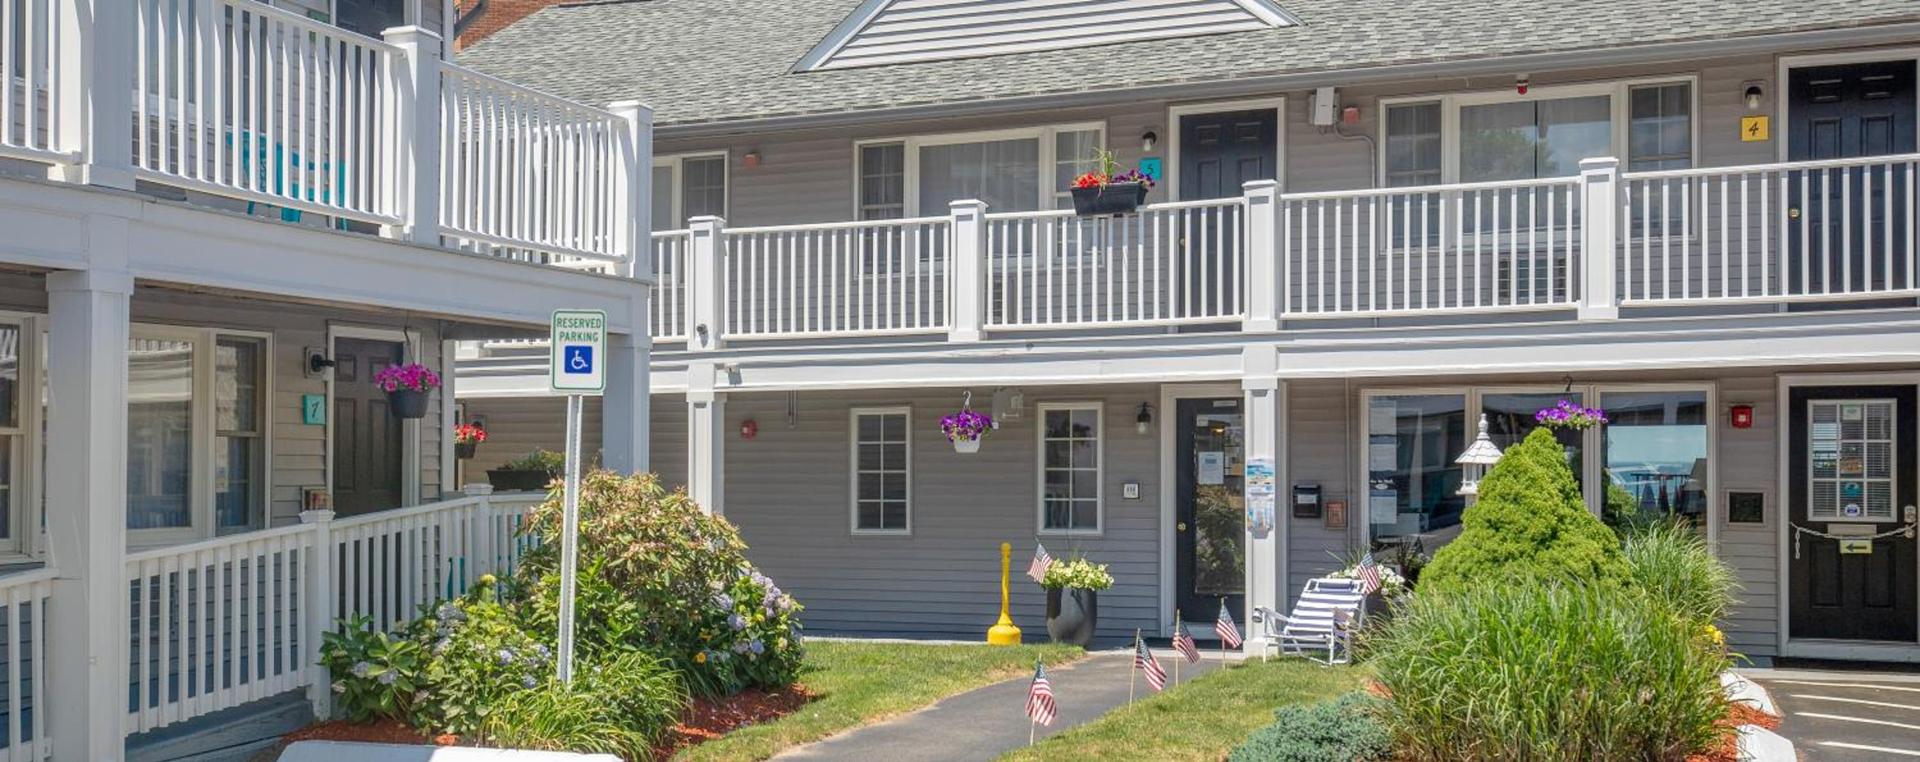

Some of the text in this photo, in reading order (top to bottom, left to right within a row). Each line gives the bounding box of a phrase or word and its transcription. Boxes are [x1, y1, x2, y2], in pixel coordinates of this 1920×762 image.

[1748, 121, 1759, 136] 4
[556, 317, 601, 329] RESERVED
[559, 331, 599, 342] PARKING
